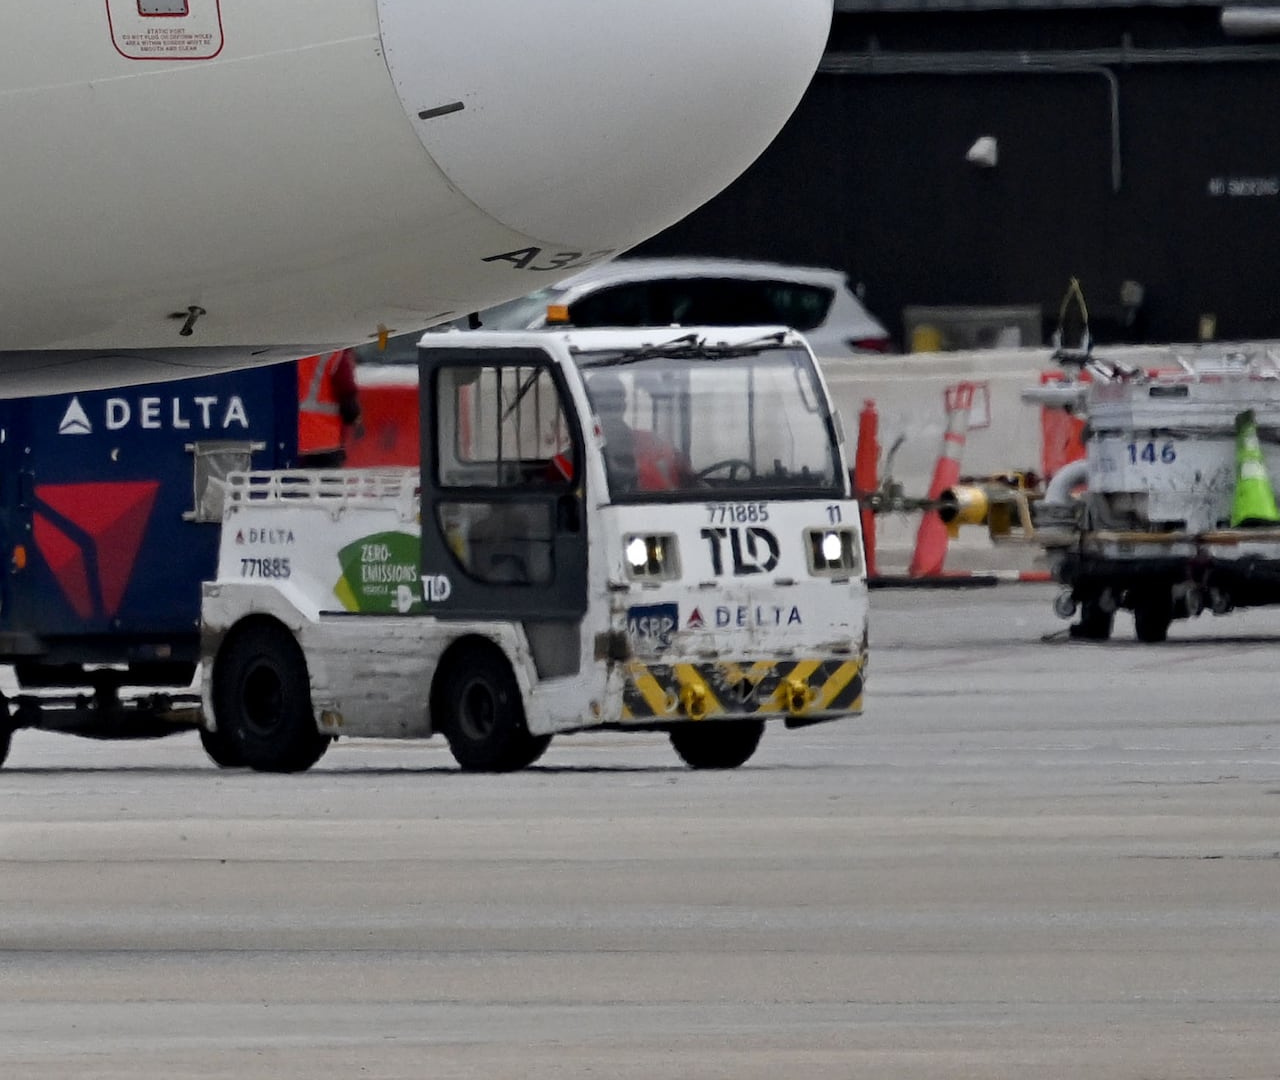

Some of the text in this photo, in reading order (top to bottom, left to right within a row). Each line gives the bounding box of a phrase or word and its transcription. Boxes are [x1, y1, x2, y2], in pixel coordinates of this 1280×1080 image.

[105, 396, 249, 430] DELTA
[1127, 440, 1177, 465] 146
[707, 504, 770, 523] 771885
[826, 504, 842, 524] 11
[249, 529, 295, 544] DELTA
[700, 527, 780, 577] TLD
[240, 558, 291, 578] 771885
[362, 564, 417, 583] EMISSIONS
[421, 574, 451, 602] TLD
[716, 605, 803, 627] DELTA
